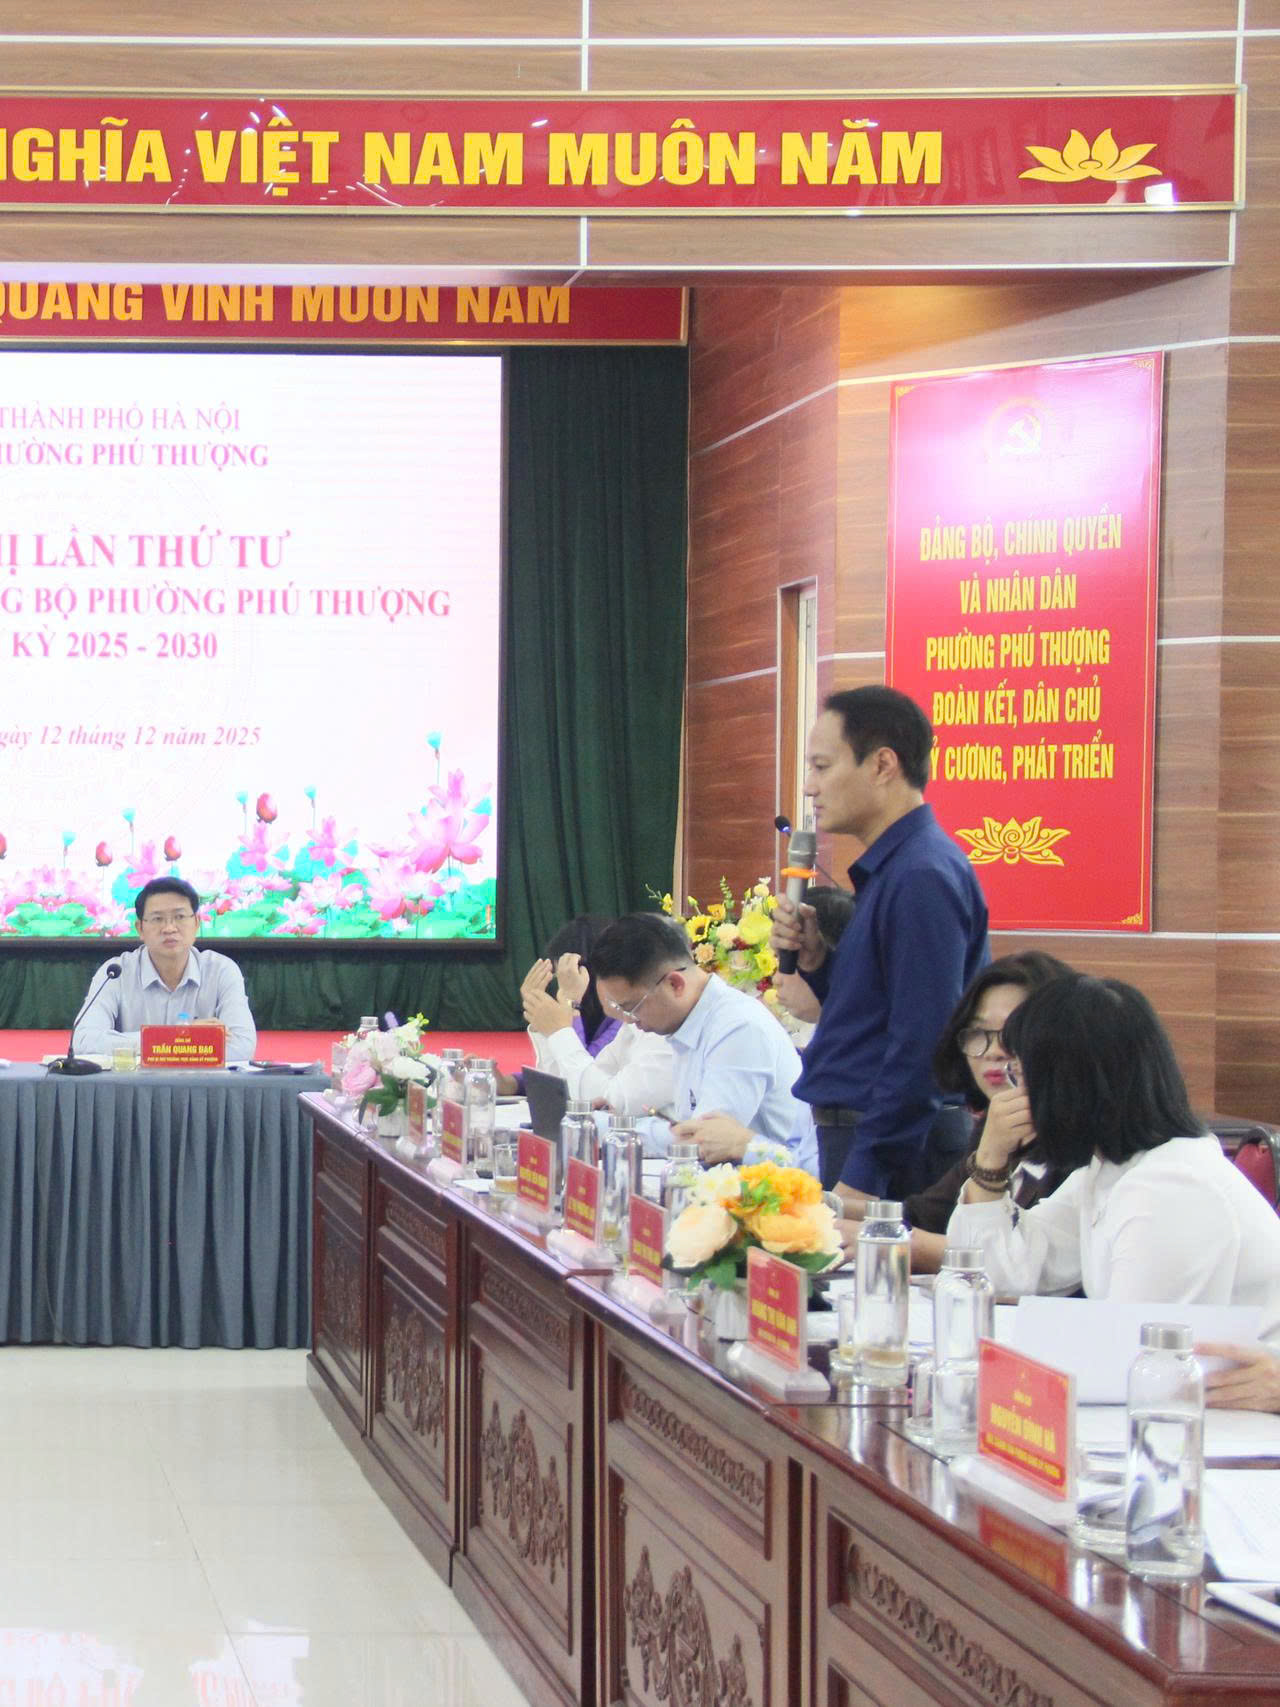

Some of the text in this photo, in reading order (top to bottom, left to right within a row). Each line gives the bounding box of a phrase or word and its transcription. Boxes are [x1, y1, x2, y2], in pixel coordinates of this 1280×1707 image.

[195, 118, 339, 196] VIỆT
[364, 132, 523, 185] NAM
[549, 119, 756, 186] MUÔN
[781, 120, 942, 184] NĂM
[163, 285, 273, 320] VINH
[152, 401, 186, 429] HÀ
[196, 401, 240, 435] NỘI
[92, 437, 144, 465] PHÚ
[152, 442, 268, 472] THƯỢNG
[32, 524, 116, 568] LẦN
[128, 524, 222, 568] THỨ
[229, 529, 292, 569] TƯ
[920, 503, 1121, 565] ĐẢNG BỘ, CHÍNH QUYỀN
[35, 584, 78, 620] BỘ
[87, 581, 226, 616] PHƯỜNG
[237, 582, 300, 616] PHÚ
[310, 586, 451, 624] THƯỢNG
[960, 568, 1076, 614] VÀ NHÂN DÂN
[13, 624, 57, 657] KỲ
[67, 632, 128, 658] 2025
[156, 632, 218, 659] 2030
[926, 625, 1110, 672] PHƯỜNG PHÚ THƯỢNG
[933, 675, 1101, 727] ĐOÀN KẾT, DÂN CHỦ
[40, 726, 62, 746] 12
[68, 724, 125, 750] tháng
[134, 726, 156, 745] 12
[162, 727, 206, 745] năm
[214, 727, 261, 746] 2025
[930, 730, 1114, 784] Ỷ CƯƠNG, PHÁT TRIỂN
